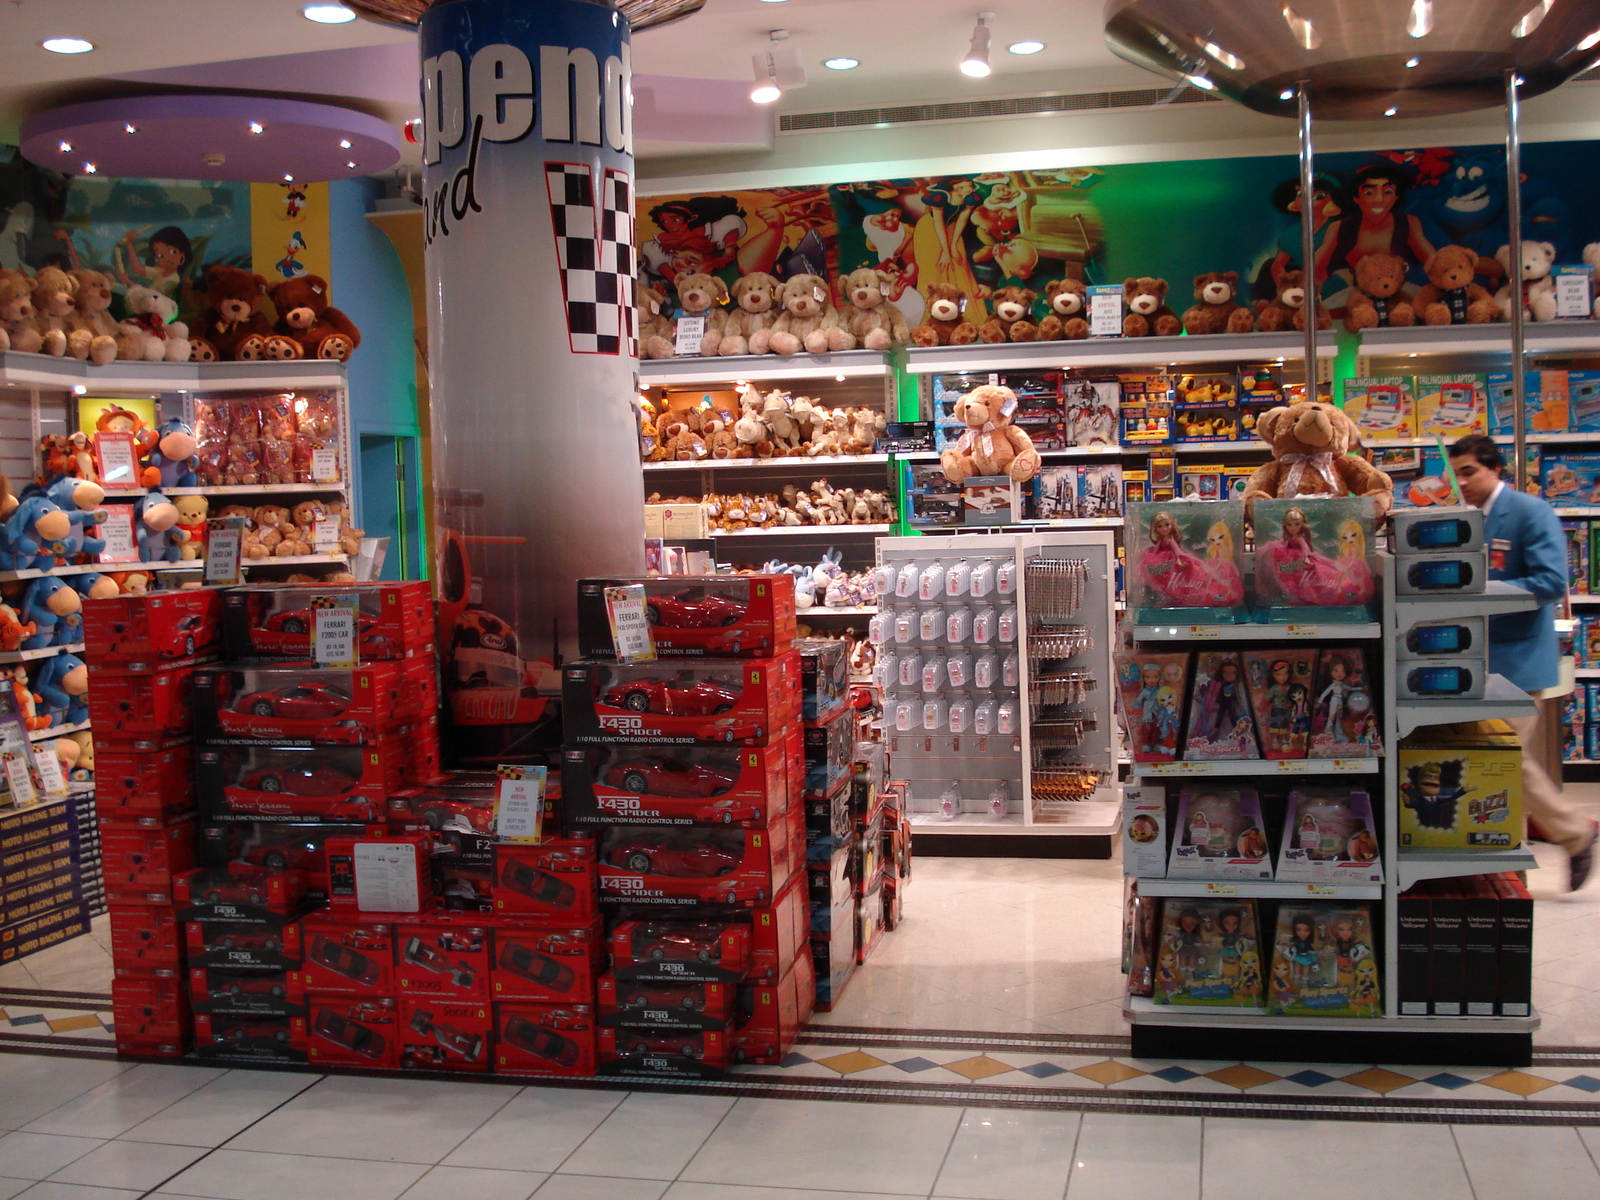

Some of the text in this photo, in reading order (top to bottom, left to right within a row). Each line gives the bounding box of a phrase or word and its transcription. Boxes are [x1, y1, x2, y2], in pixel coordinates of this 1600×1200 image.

[1345, 377, 1403, 387] TRILINGUAL LAPTOP
[1418, 374, 1477, 384] TRILINGUAL LAPTOP
[619, 612, 640, 621] FERRARI
[598, 715, 642, 729] F430
[1469, 762, 1518, 771] PS2
[597, 795, 640, 809] F430
[1, 805, 67, 830] MOTO RACING TEAM
[2, 822, 68, 848] MOTO RACING TEAM
[3, 839, 70, 867] MOTO RACING TEAM
[6, 856, 70, 883] MOTO RACING TEAM
[6, 873, 72, 901] MOTO RACING TEAM
[600, 875, 644, 889] F430
[8, 890, 72, 920] MOTO RACING TEAM
[18, 905, 80, 936] MOTO RACING TEAM
[18, 922, 82, 951] MOTO RACING TEAM
[660, 963, 685, 971] F430
[643, 1010, 668, 1019] F430
[643, 1058, 667, 1066] F430
